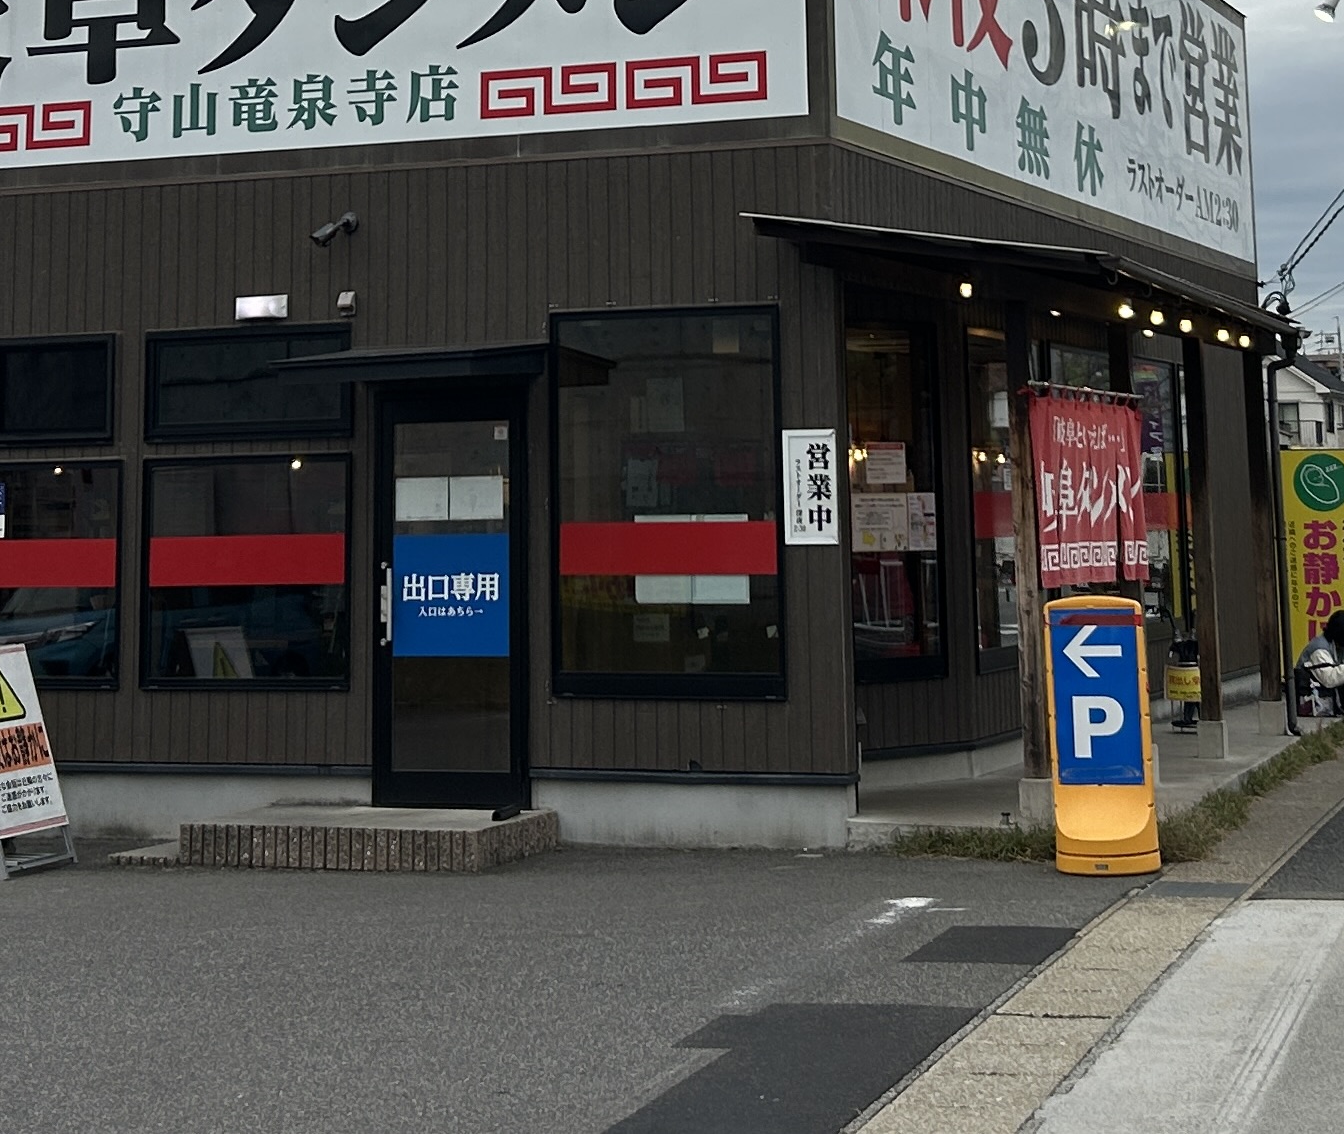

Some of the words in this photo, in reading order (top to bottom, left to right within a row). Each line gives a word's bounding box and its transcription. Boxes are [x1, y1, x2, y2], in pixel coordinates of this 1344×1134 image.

[112, 65, 459, 144] 守山竜泉寺店
[872, 30, 1104, 197] 年中無休
[806, 443, 832, 532] 営業中
[402, 572, 499, 601] 出口専用
[1072, 695, 1125, 759] P
